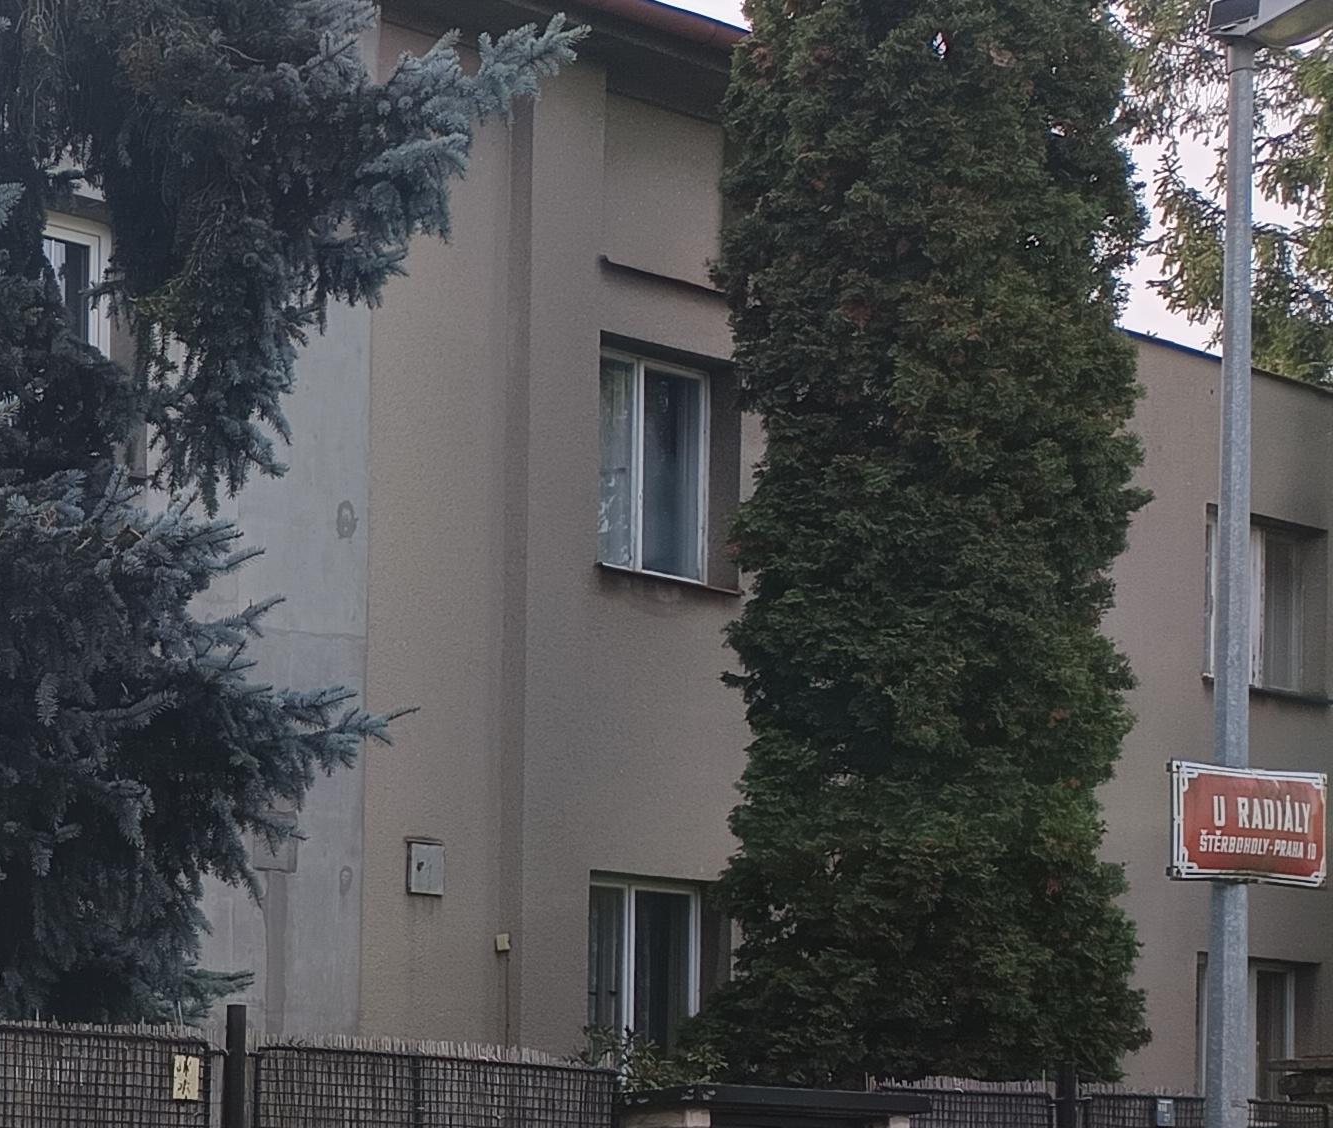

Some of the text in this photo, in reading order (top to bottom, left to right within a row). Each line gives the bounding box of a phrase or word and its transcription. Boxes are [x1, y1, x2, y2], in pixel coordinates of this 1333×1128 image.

[1213, 794, 1312, 834] U RADIÁLY
[1307, 843, 1317, 860] 10
